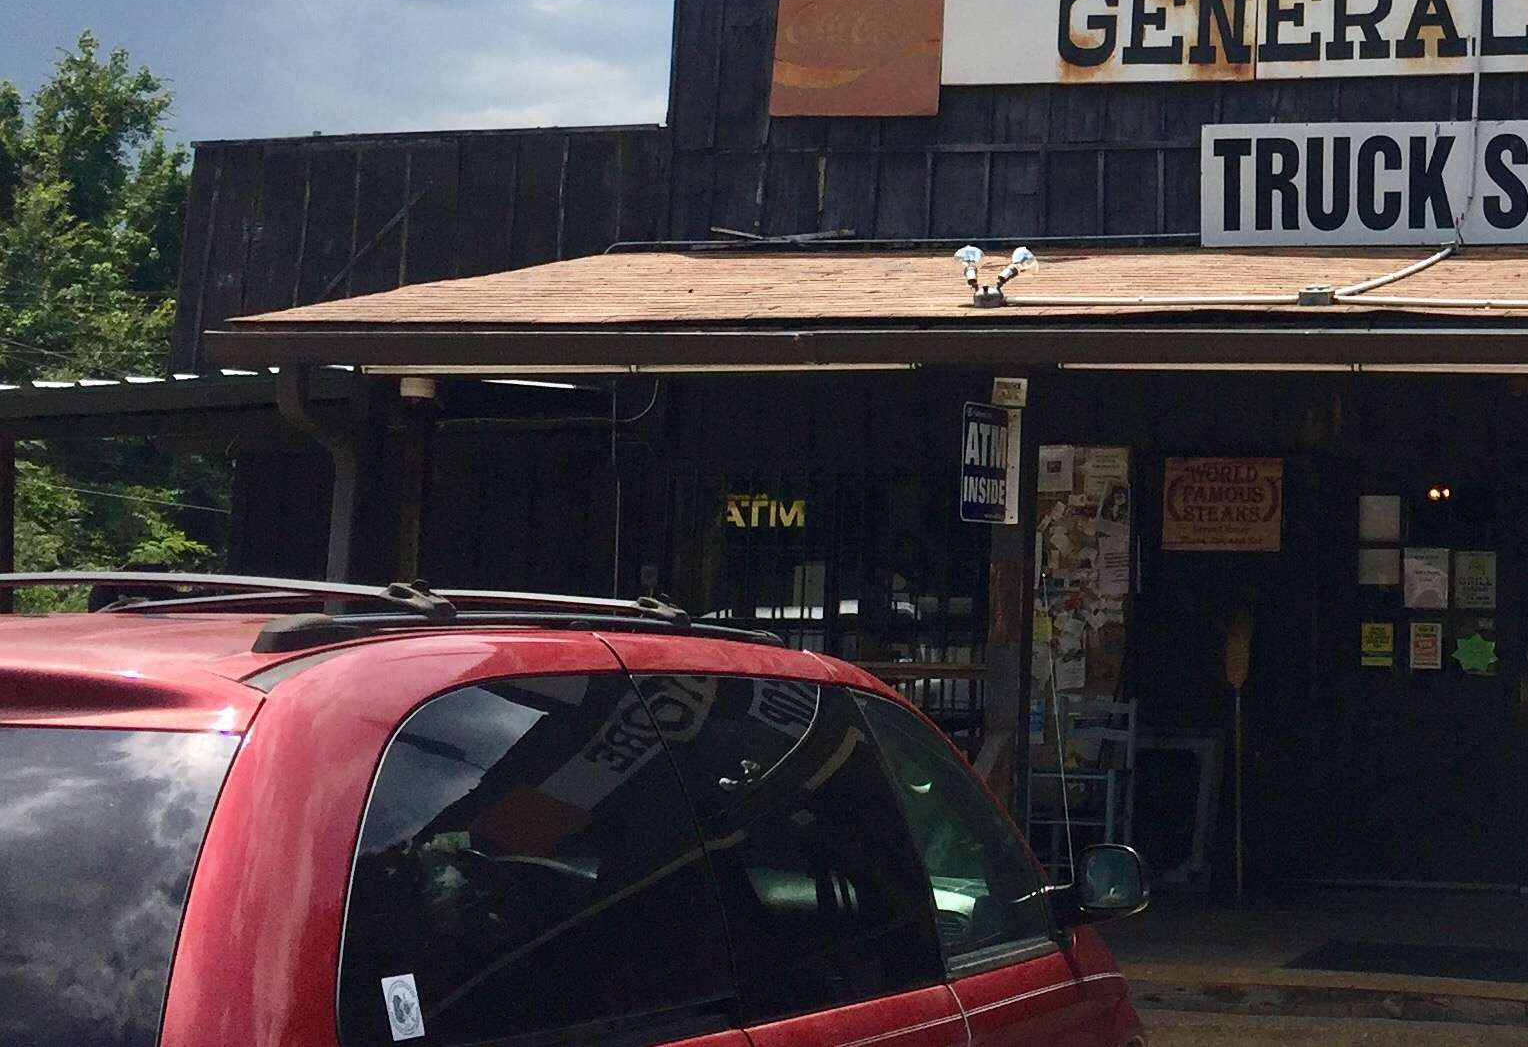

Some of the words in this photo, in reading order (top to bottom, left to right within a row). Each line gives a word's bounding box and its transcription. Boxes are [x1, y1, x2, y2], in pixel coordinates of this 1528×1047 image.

[1213, 134, 1458, 232] TRUCK
[965, 421, 1007, 469] ATM
[1185, 464, 1258, 483] WORLD
[963, 475, 1007, 506] INSIDE
[1182, 486, 1264, 503] FAMOUS
[1182, 505, 1262, 523] STEAKS
